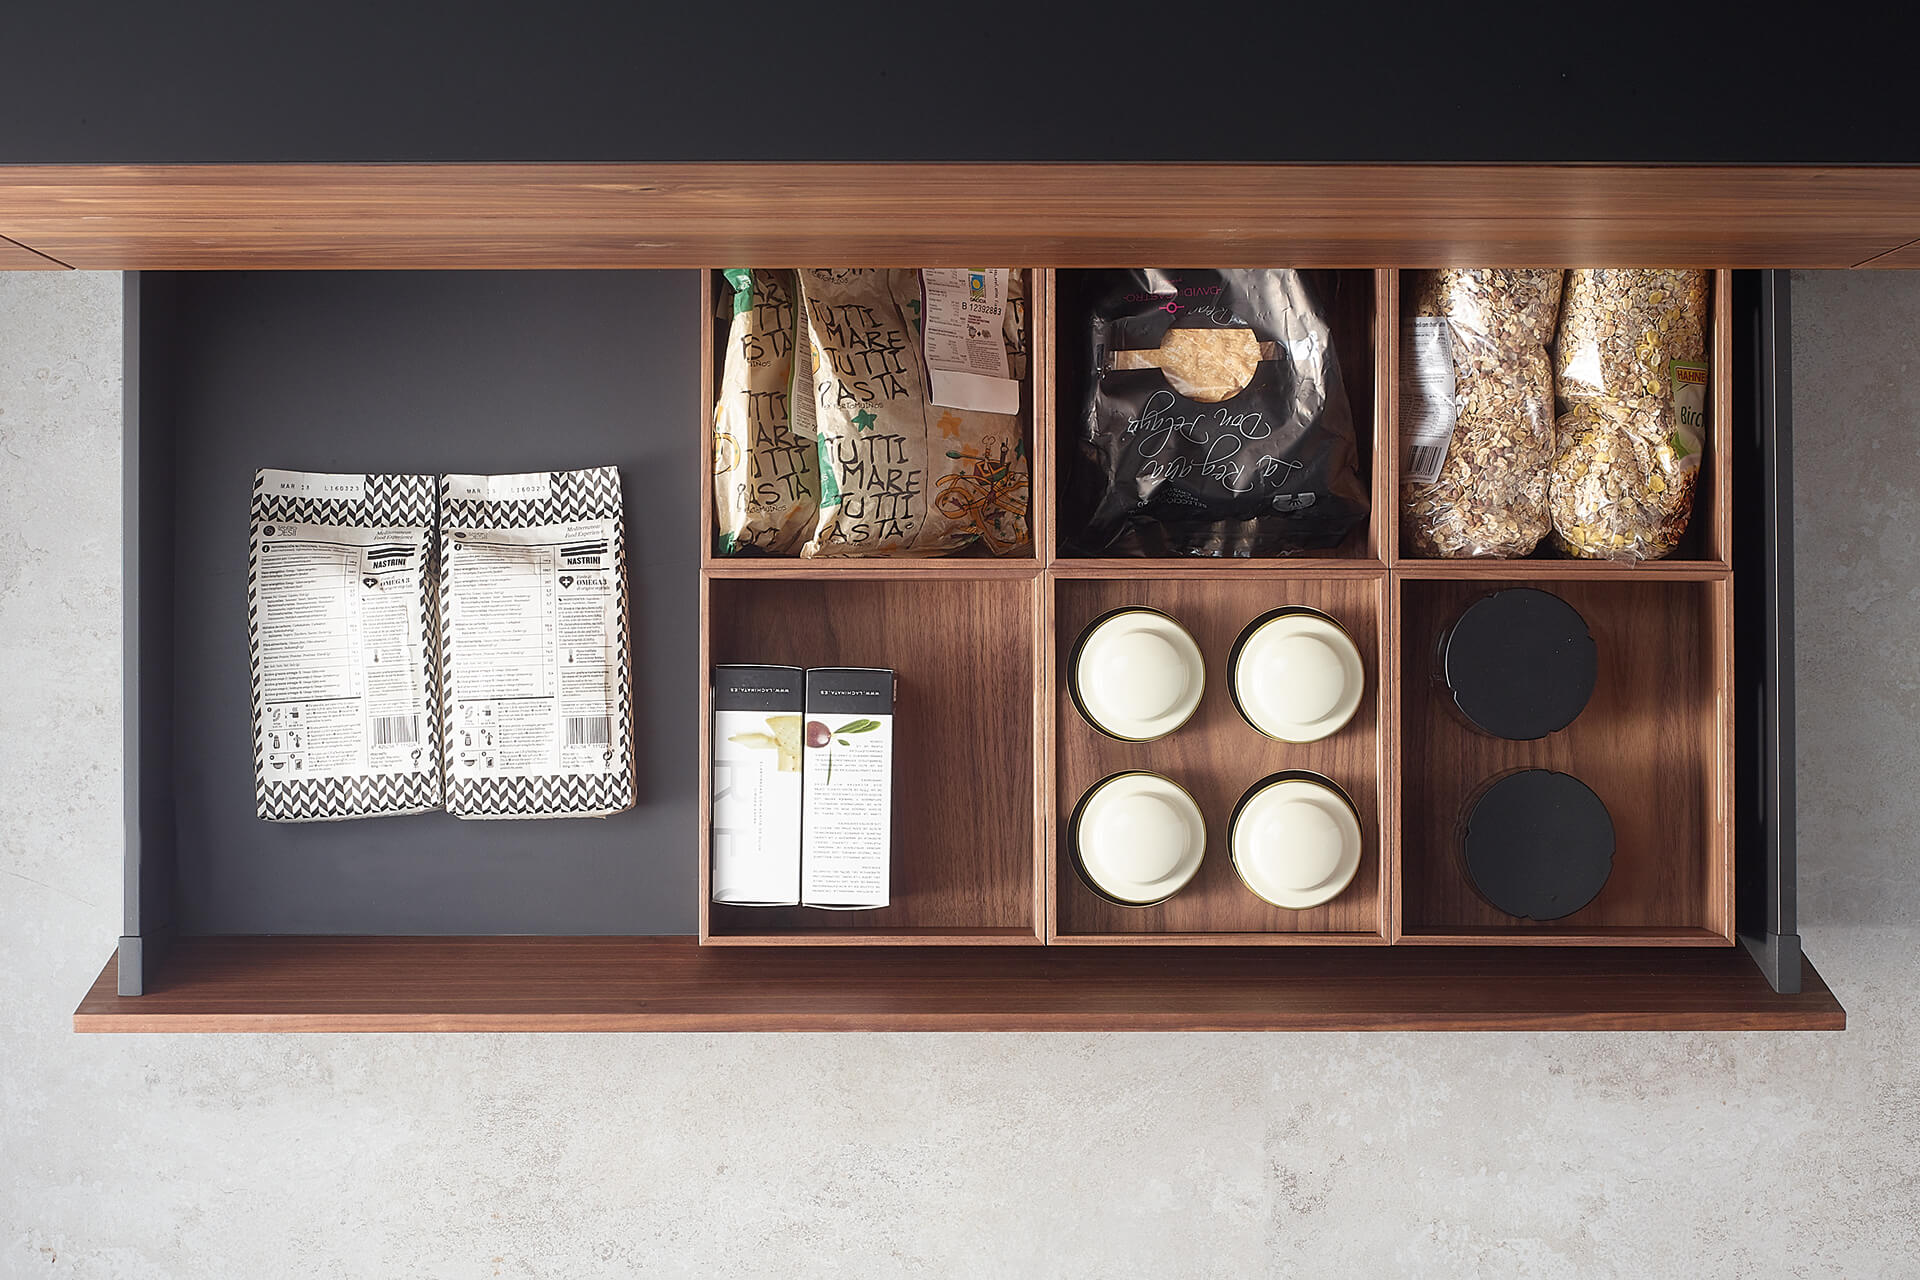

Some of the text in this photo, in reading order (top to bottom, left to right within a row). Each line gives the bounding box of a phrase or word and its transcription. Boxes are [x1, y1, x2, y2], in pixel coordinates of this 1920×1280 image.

[808, 296, 884, 329] TUTTI
[961, 301, 968, 310] B
[826, 323, 906, 351] MARE
[823, 347, 908, 377] TUTTI
[818, 373, 910, 407] PASTA
[1213, 408, 1273, 440] Don
[824, 434, 909, 464] TUTTI
[841, 461, 922, 494] MARE
[1256, 454, 1304, 488] La
[832, 491, 914, 520] TUTTI
[372, 558, 407, 569] NASTRINI
[567, 556, 601, 565] NASTRINI
